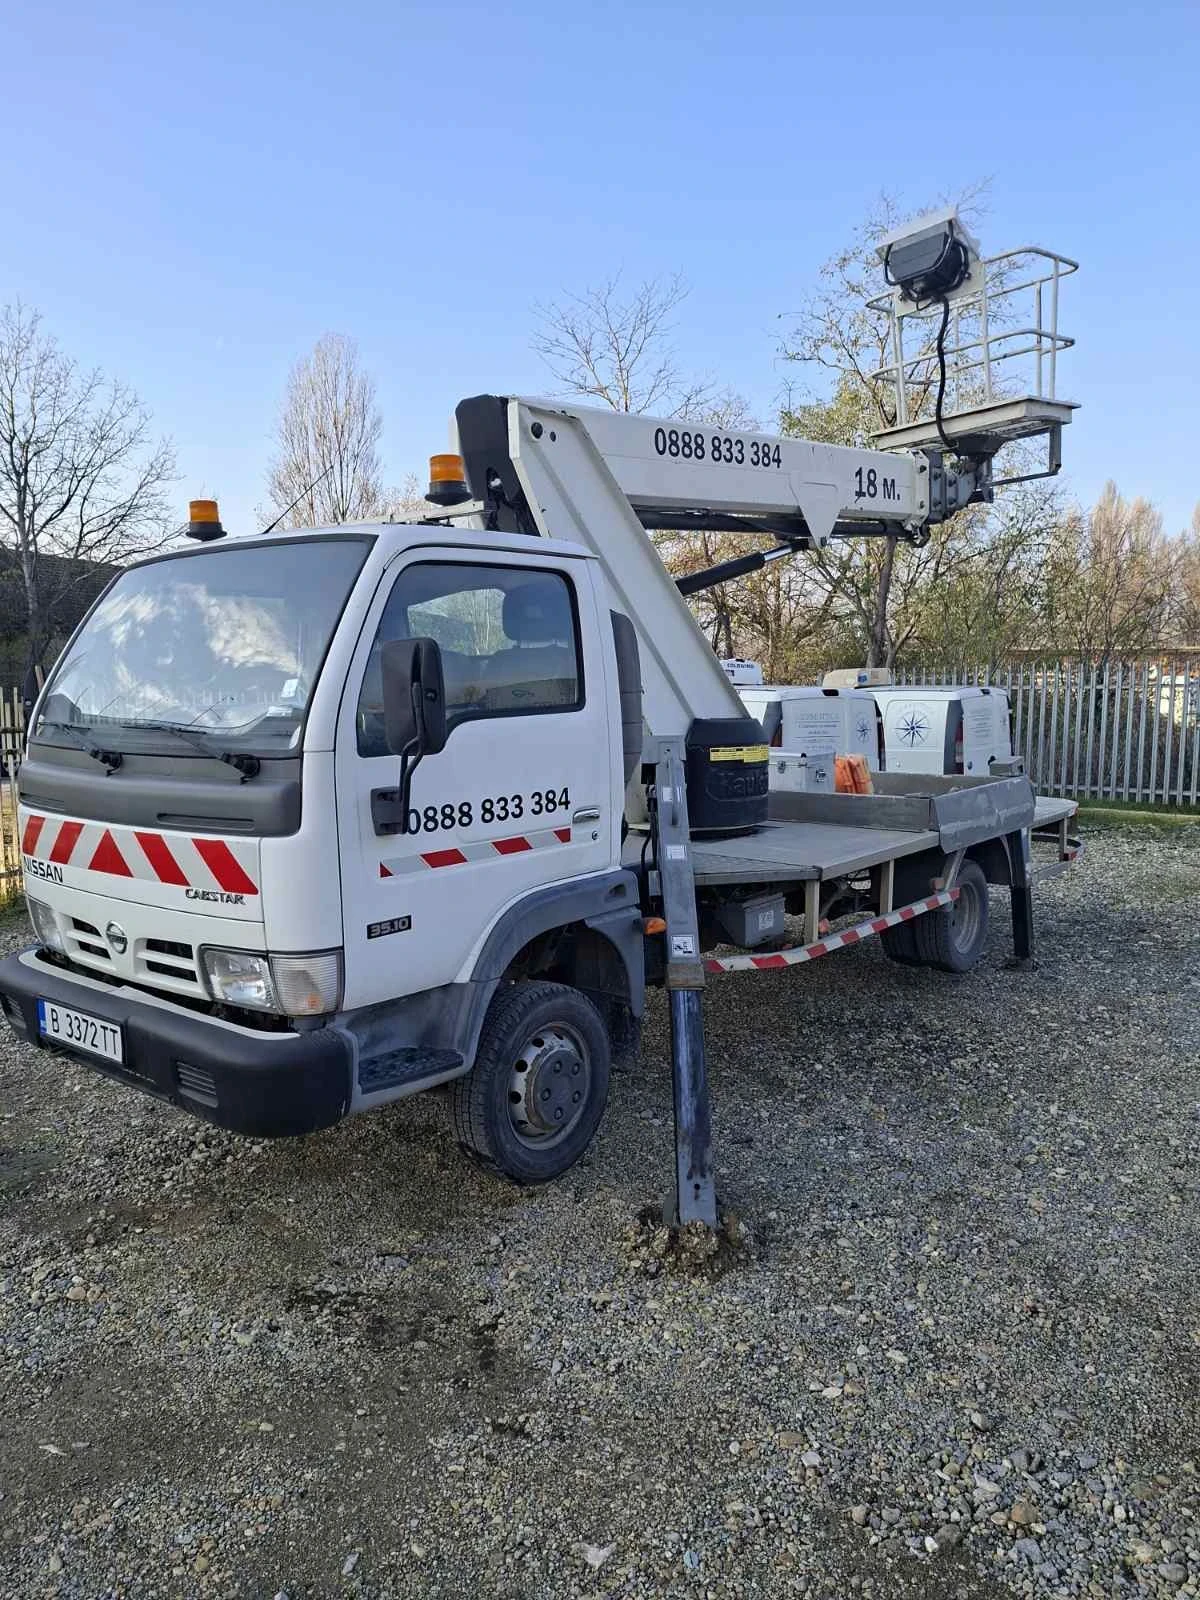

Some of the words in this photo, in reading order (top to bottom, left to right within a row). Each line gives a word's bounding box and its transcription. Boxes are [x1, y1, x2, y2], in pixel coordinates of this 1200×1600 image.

[654, 427, 706, 460] 0888
[711, 435, 745, 465] 833
[750, 441, 782, 468] 384
[854, 466, 878, 499] 18
[407, 801, 473, 835] 0888
[481, 794, 524, 824] 833
[530, 787, 571, 816] 384
[23, 855, 64, 883] NISSAN
[369, 916, 409, 938] 35.10
[50, 1007, 60, 1033] B
